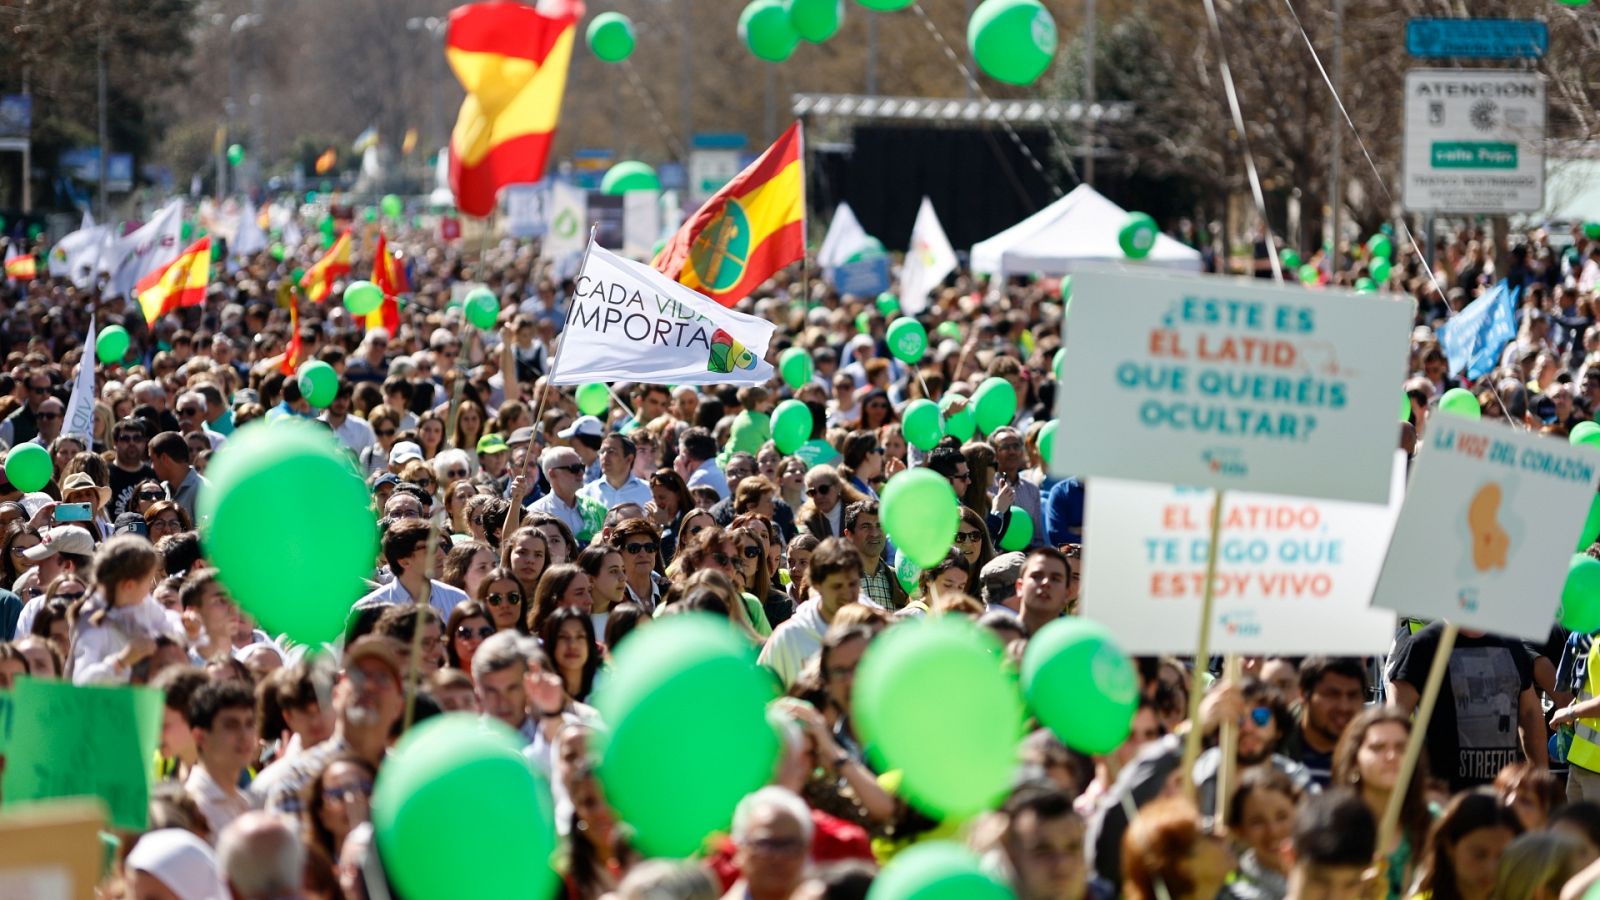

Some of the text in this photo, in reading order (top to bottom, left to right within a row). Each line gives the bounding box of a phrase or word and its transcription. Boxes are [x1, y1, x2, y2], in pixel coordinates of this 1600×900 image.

[574, 276, 645, 311] CADA
[565, 299, 709, 349] IMPORTA
[1274, 304, 1315, 333] ES
[1149, 328, 1297, 369] EL LATID
[1115, 362, 1347, 409] QUE QUERÉIS
[69, 397, 92, 434] VID
[1139, 401, 1317, 443] OCULTAR?
[1434, 426, 1456, 450] LA
[1457, 430, 1490, 461] VOZ
[1489, 438, 1519, 468] DEL
[1163, 504, 1198, 530] EL
[1145, 536, 1343, 564] TE DGO QUE
[1149, 571, 1333, 600] ESTOY VIVO
